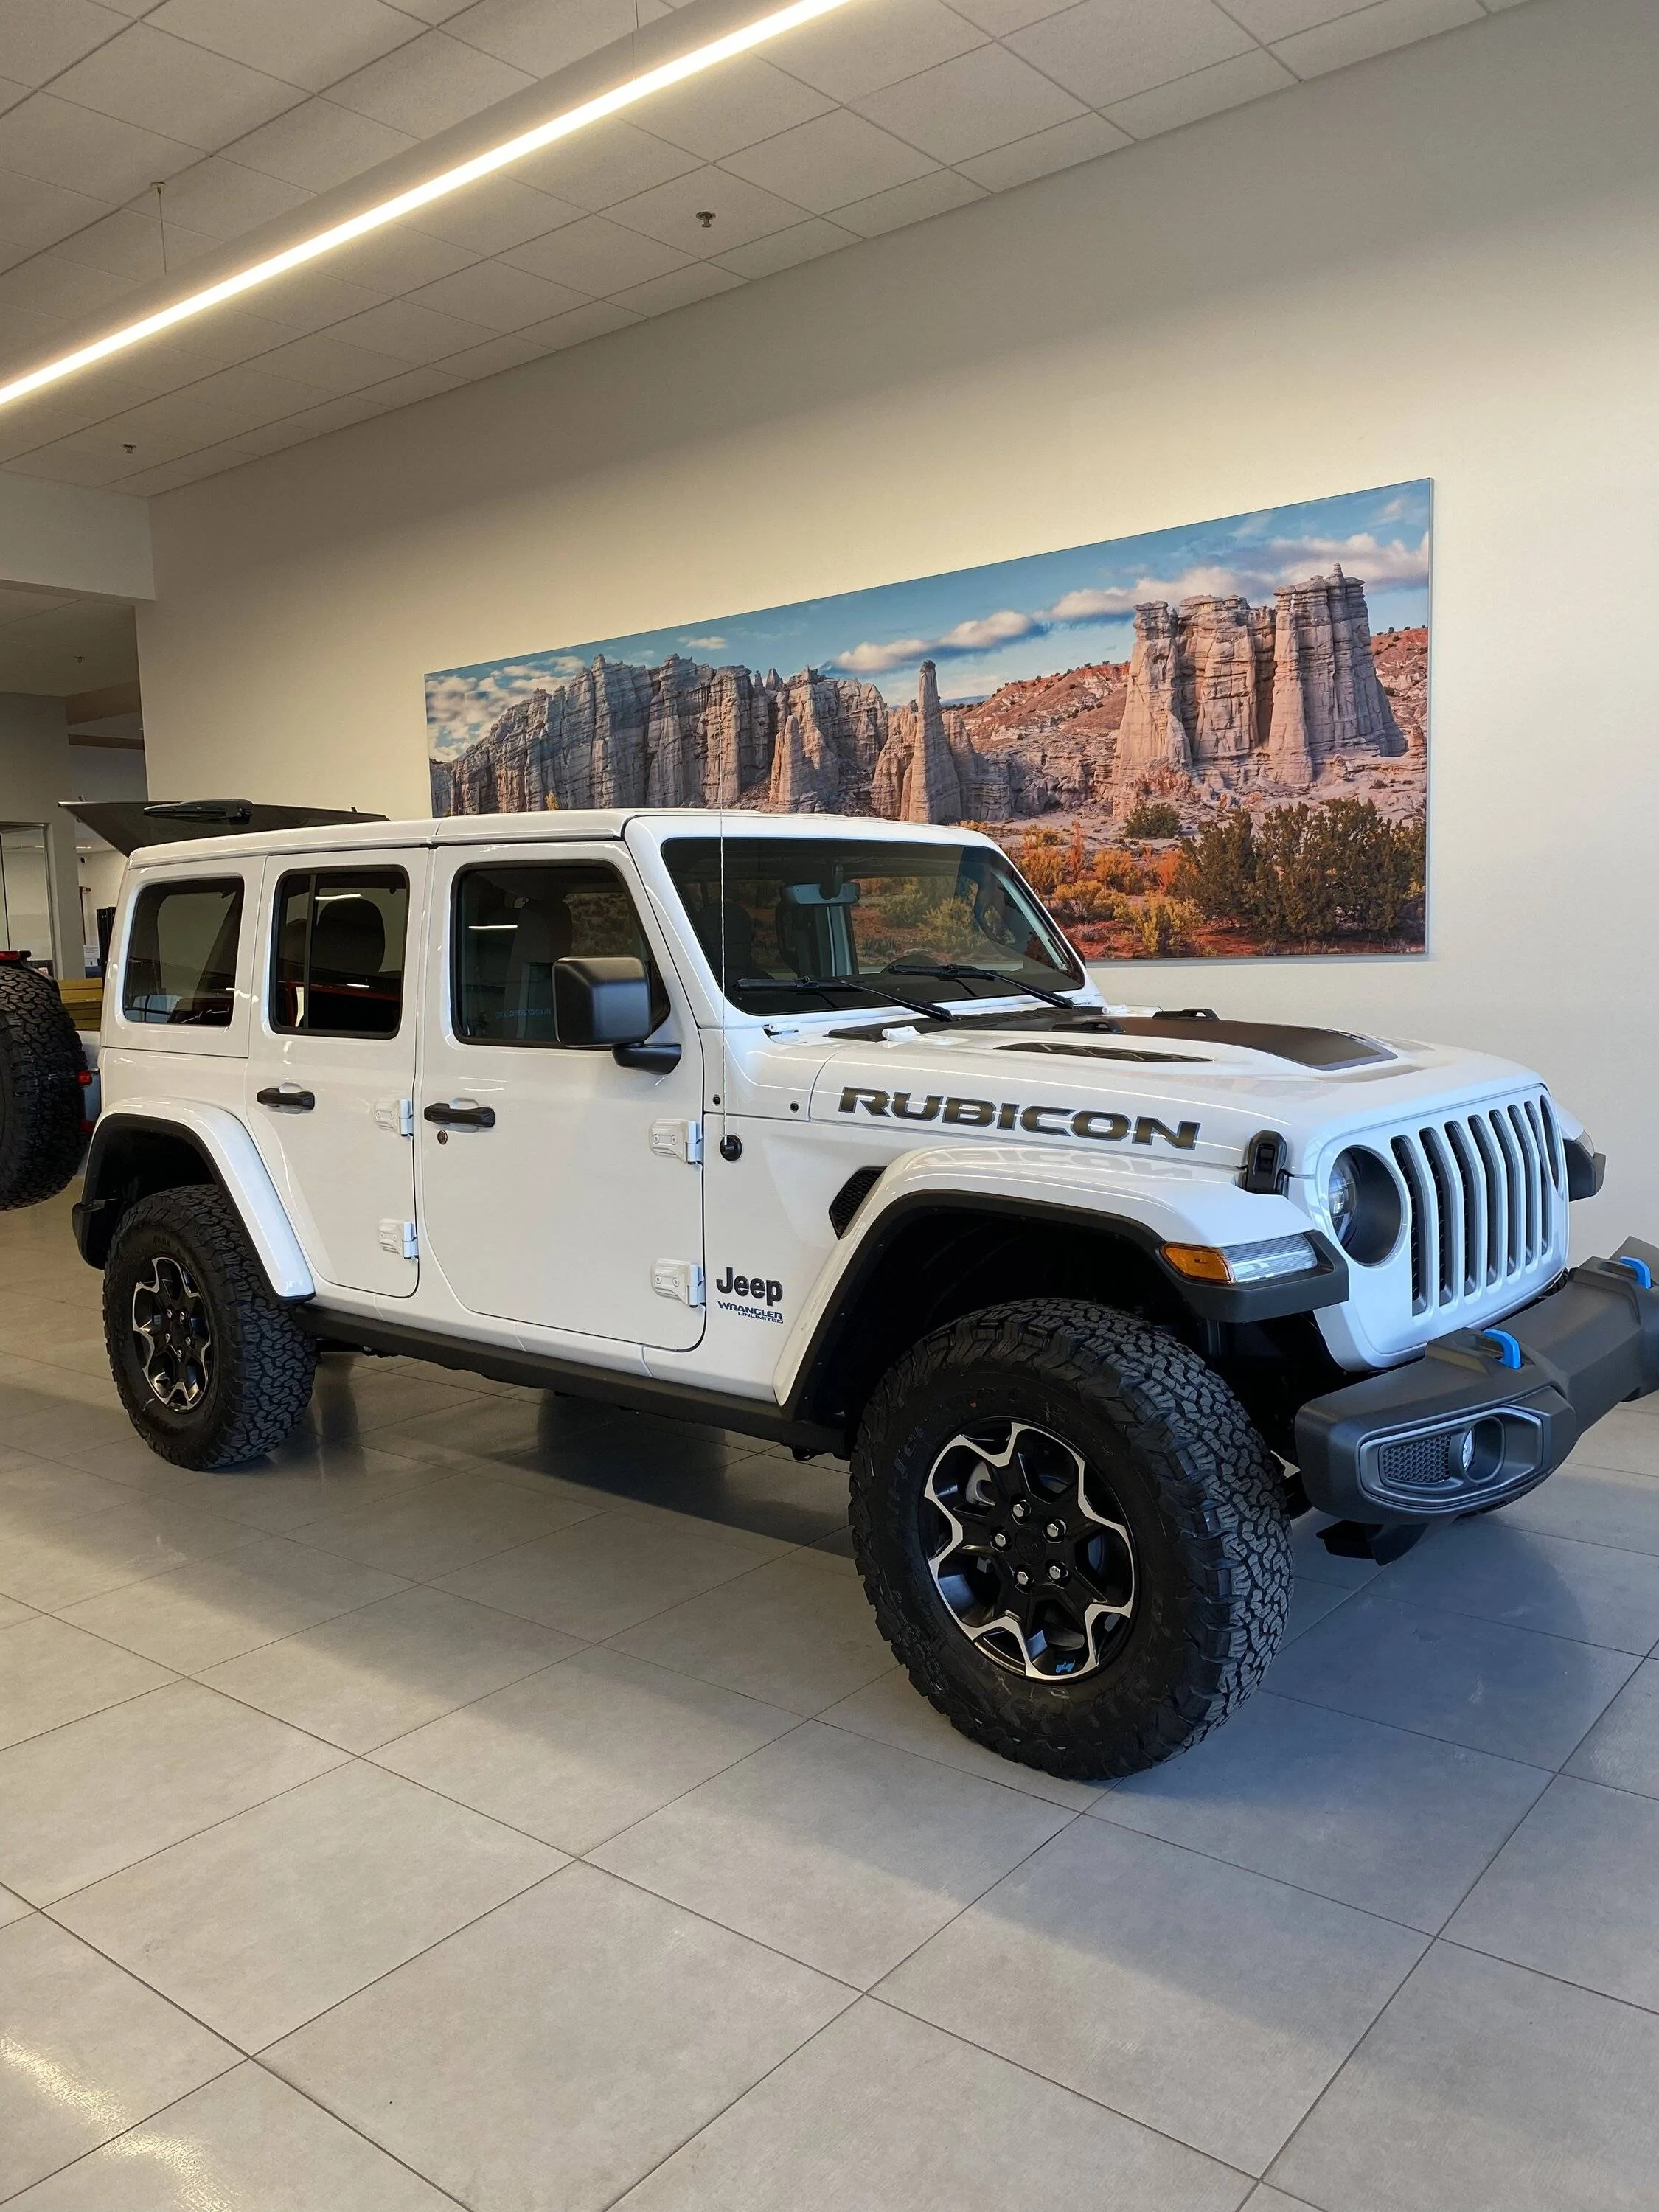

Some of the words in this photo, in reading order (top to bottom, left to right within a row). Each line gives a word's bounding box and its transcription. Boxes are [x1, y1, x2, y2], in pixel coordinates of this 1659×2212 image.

[838, 1086, 1200, 1150] RUBICON
[715, 1266, 783, 1307] Jeep
[717, 1300, 784, 1321] WRANGLER
[738, 1312, 784, 1324] UNLIMITED
